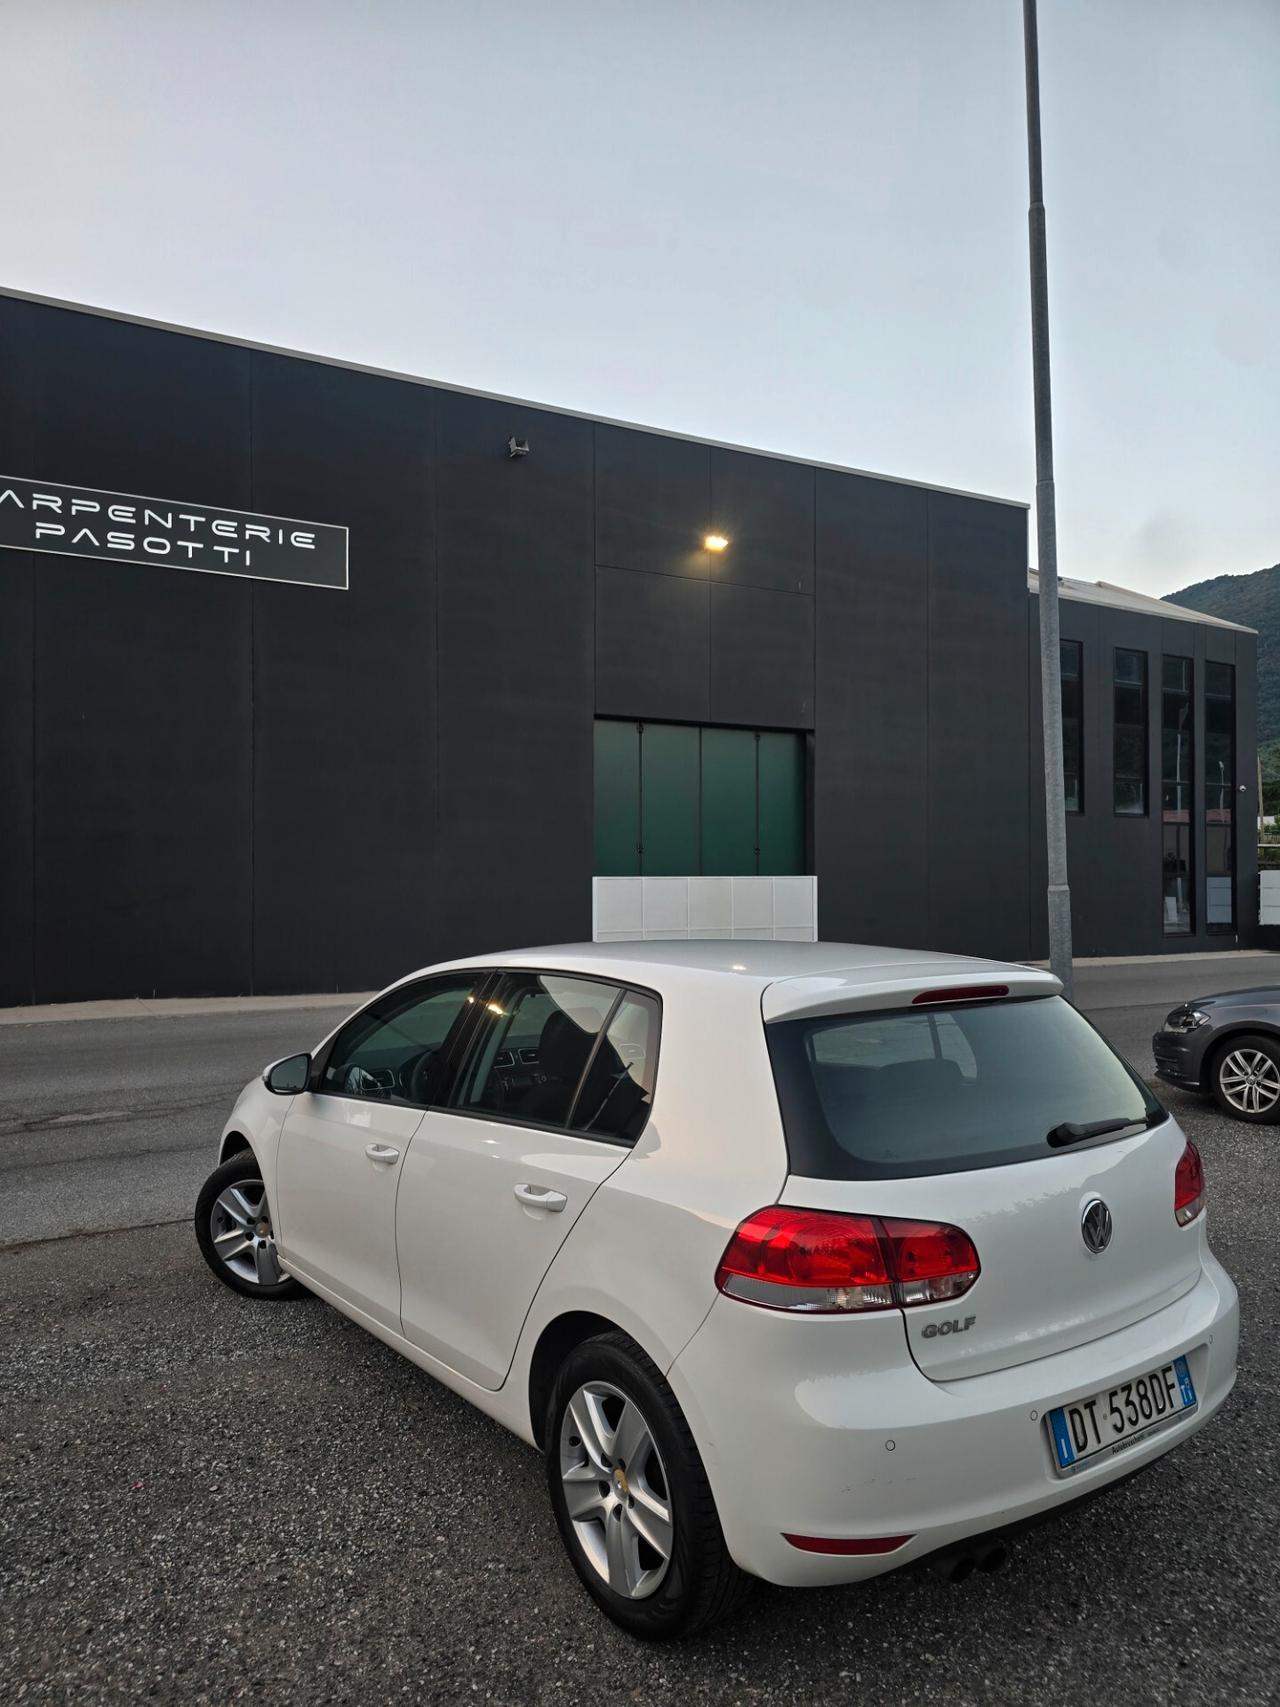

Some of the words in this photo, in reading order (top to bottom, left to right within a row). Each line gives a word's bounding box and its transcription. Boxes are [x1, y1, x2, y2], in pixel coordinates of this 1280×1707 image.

[35, 521, 251, 567] PASOTTI
[921, 1315, 977, 1339] GOLF
[1068, 1399, 1102, 1454] DT
[1108, 1365, 1176, 1434] 538DF
